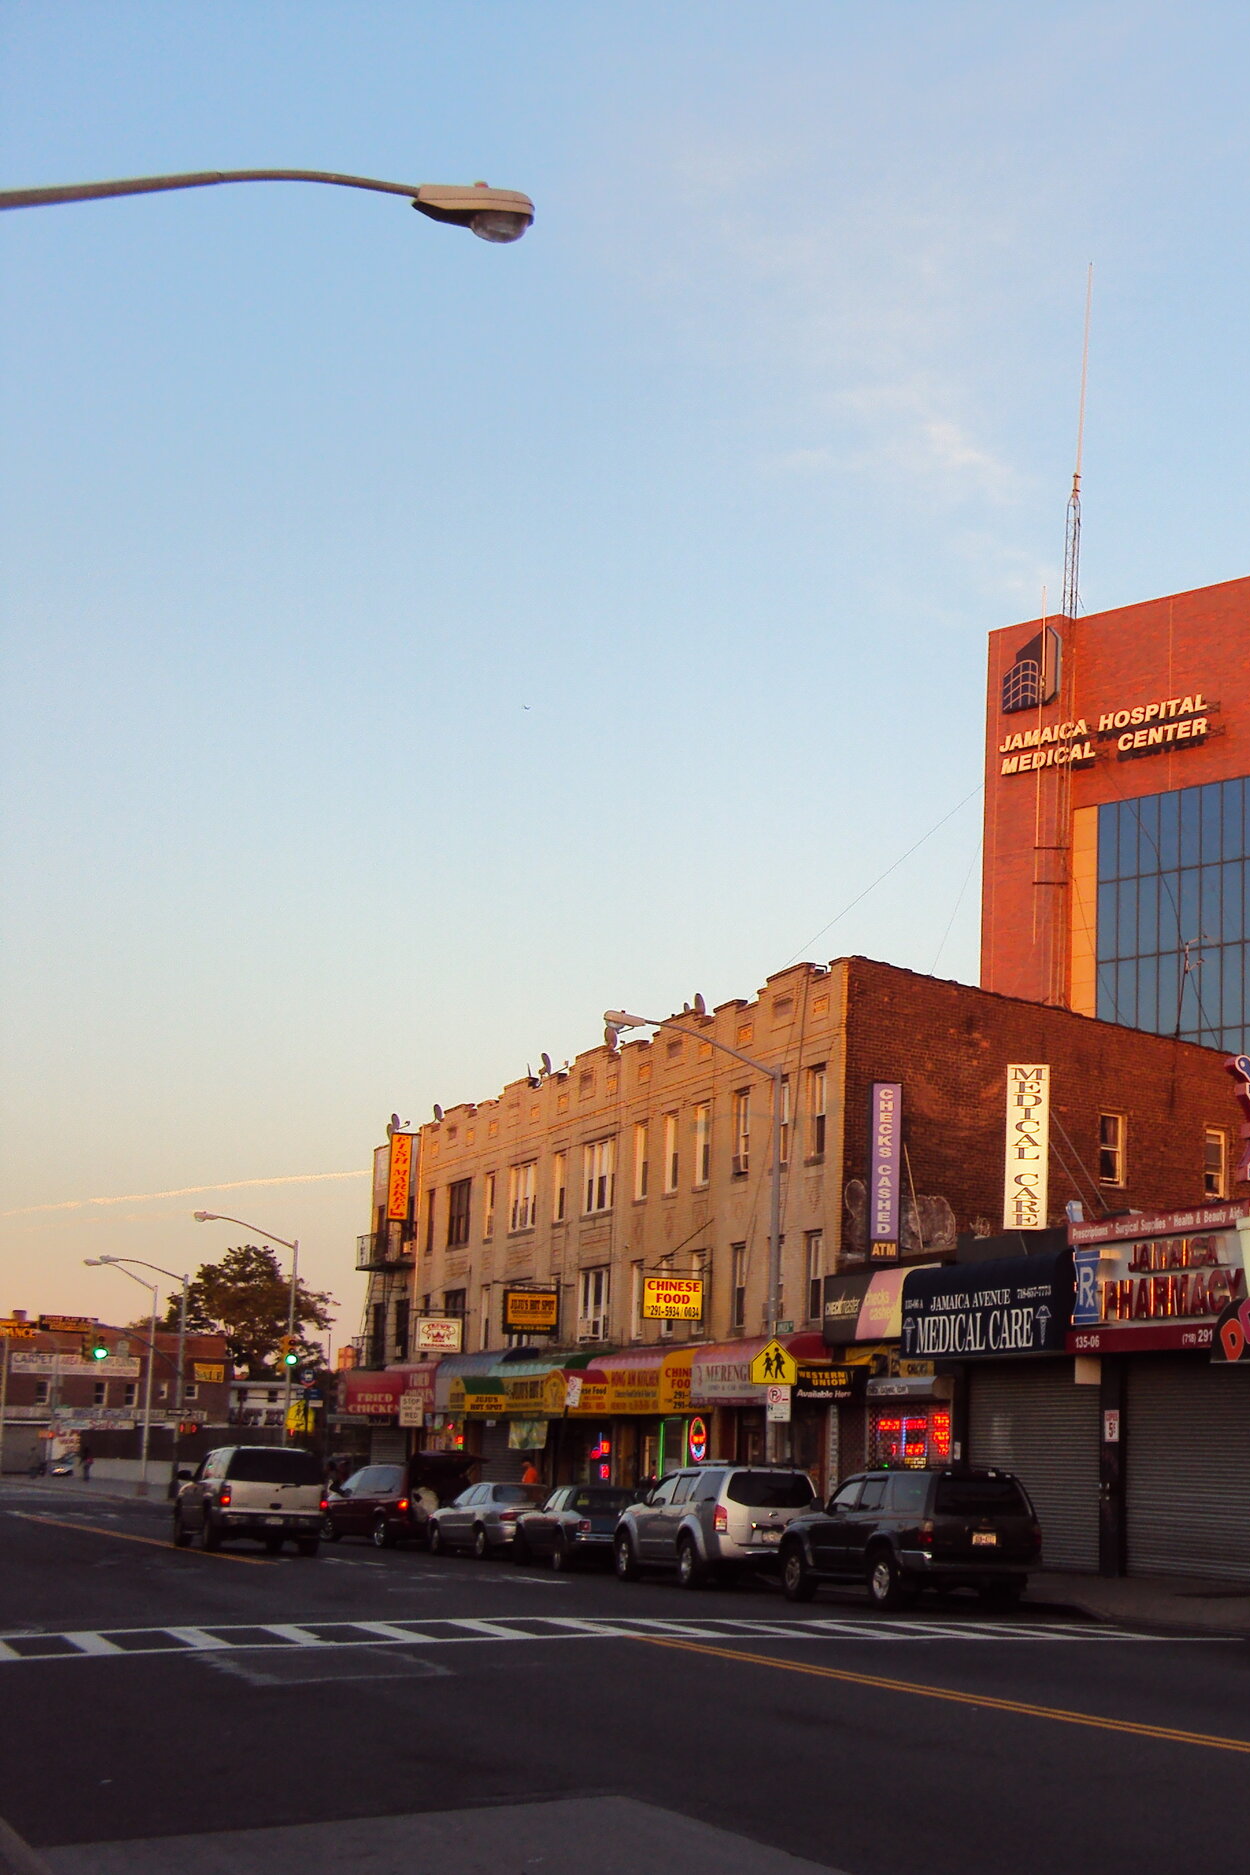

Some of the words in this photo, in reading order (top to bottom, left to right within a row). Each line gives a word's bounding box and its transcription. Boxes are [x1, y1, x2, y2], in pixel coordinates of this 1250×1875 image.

[999, 719, 1088, 753] JAMAICA
[1098, 695, 1208, 732] HOSPITAL
[1001, 742, 1096, 776] MEDICAL
[1117, 717, 1208, 751] CENTER
[878, 1089, 893, 1158] CHECKS
[1011, 1067, 1045, 1160] MEDICAL
[394, 1136, 410, 1164] FISH
[392, 1169, 408, 1211] MARKET
[877, 1165, 892, 1234] CASHED
[1011, 1173, 1041, 1227] CARE
[1072, 1224, 1109, 1240] Prescriptions
[1115, 1220, 1138, 1236] Surgical
[1140, 1216, 1166, 1232] Supplies
[1173, 1211, 1194, 1227] Health
[1203, 1208, 1227, 1225] Beauty
[1229, 1206, 1244, 1220] Aids
[872, 1243, 897, 1257] ATM
[1128, 1236, 1218, 1272] JAMAICA
[648, 1280, 700, 1292] CHINESE
[656, 1293, 690, 1304] FOOD
[930, 1293, 970, 1312] JAMAICA
[973, 1288, 1011, 1307] AVENUE
[1102, 1268, 1245, 1321] PHARMACY
[916, 1312, 987, 1354] MEDICAL
[988, 1307, 1035, 1350] CARE
[1075, 1335, 1100, 1349] 135-06
[1182, 1333, 1197, 1345] (718)
[13, 1354, 53, 1365] CARPET
[797, 1371, 846, 1379] WESTERN
[357, 1393, 394, 1403] FRIED
[671, 1378, 691, 1388] FOO
[796, 1389, 833, 1399] Available
[834, 1390, 852, 1398] Here
